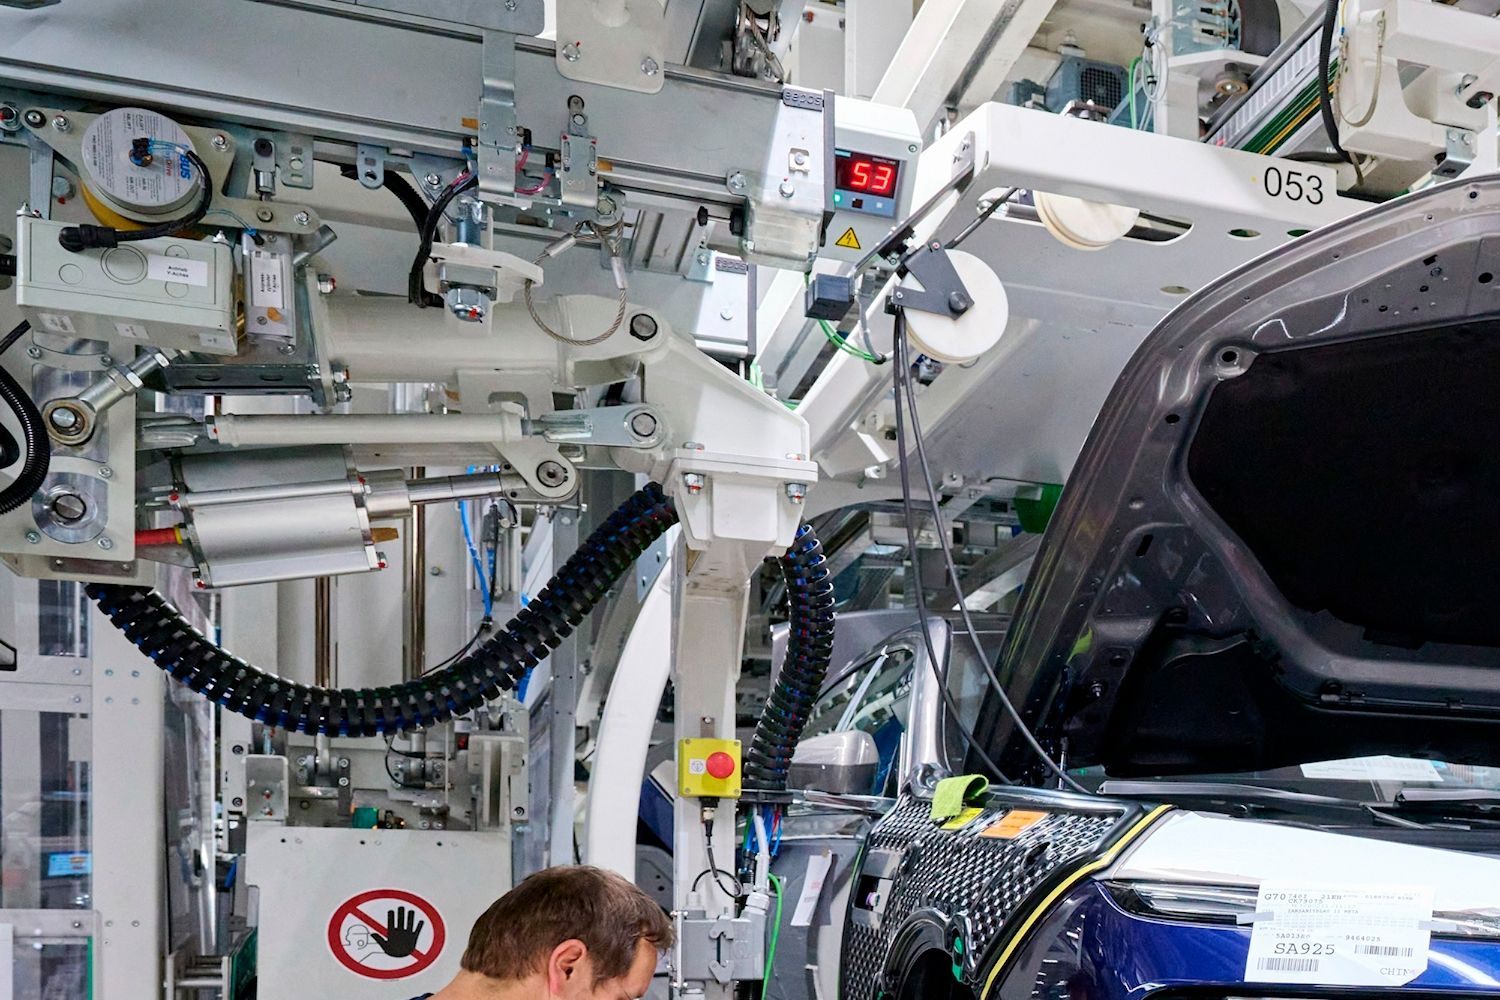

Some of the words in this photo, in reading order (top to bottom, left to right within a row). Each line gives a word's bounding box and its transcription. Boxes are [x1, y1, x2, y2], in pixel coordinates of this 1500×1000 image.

[851, 162, 892, 190] 53
[1264, 167, 1324, 205] 053
[1264, 893, 1286, 901] G70
[1274, 943, 1335, 955] SA925
